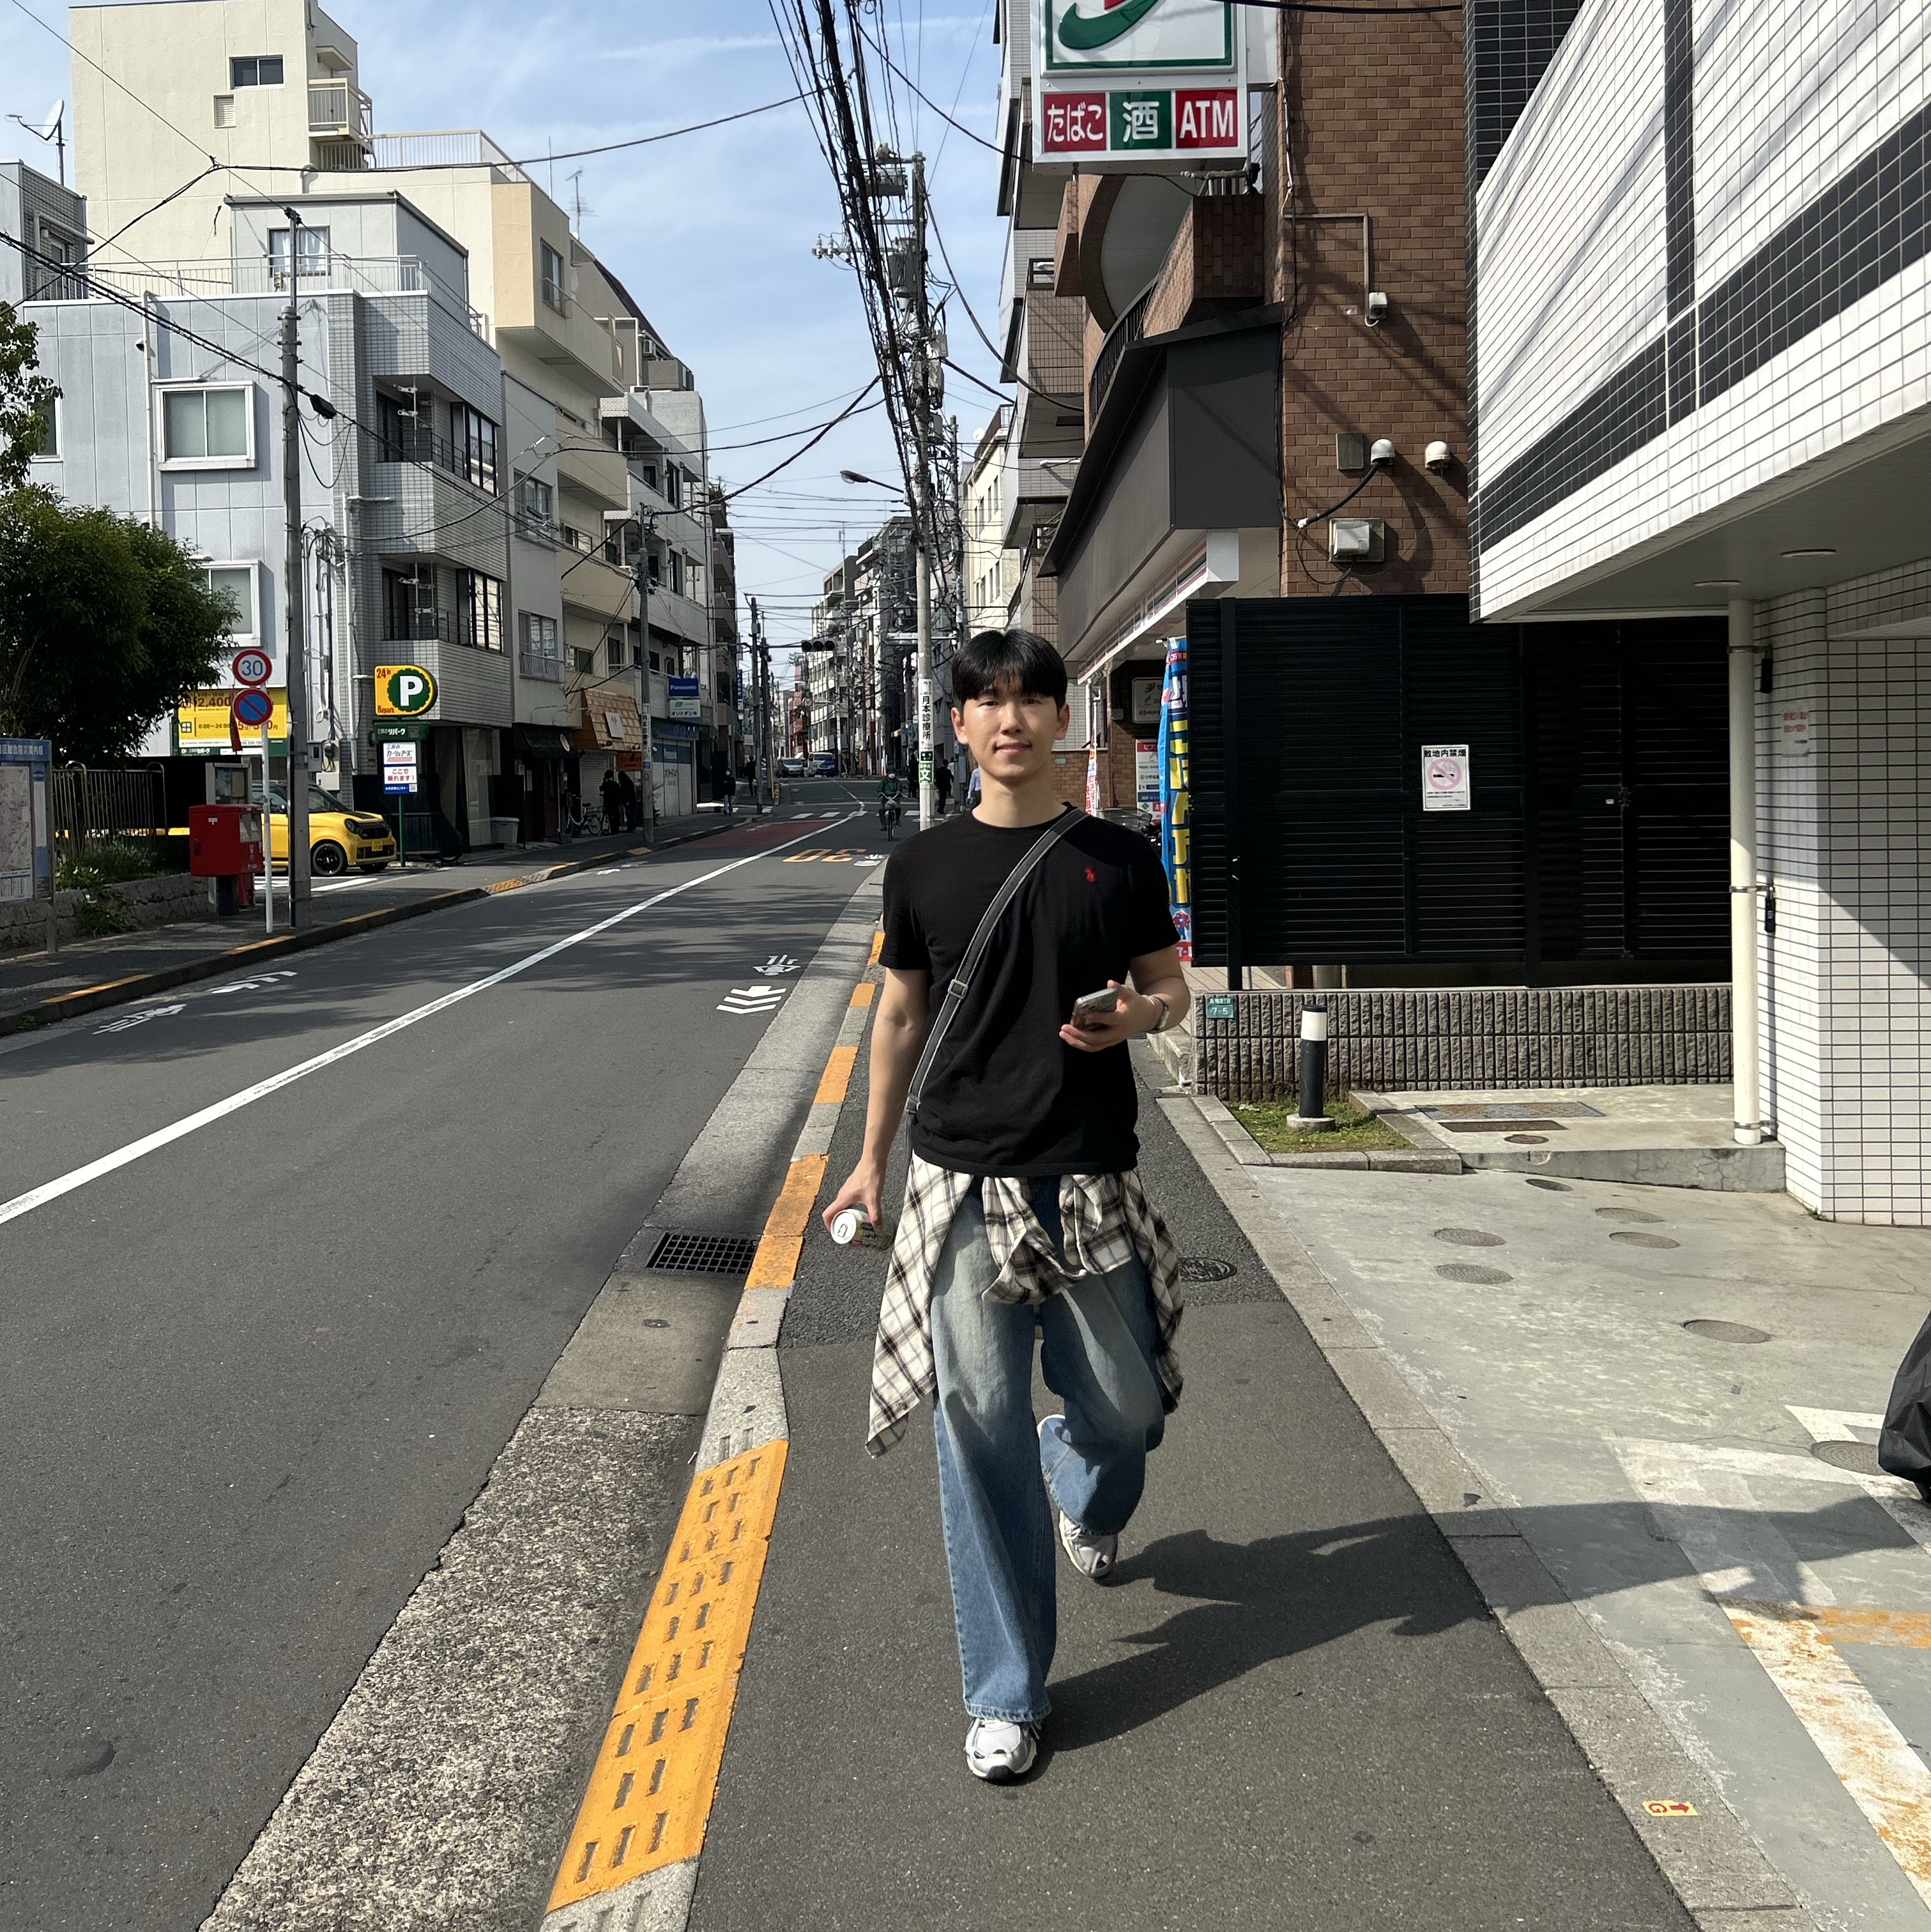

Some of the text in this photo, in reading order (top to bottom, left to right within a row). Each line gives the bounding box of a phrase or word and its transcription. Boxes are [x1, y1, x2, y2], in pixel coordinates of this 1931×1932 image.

[1047, 100, 1104, 143] たばこ
[1122, 100, 1160, 143] 酒
[1179, 100, 1234, 139] ATM
[242, 660, 263, 676] 30
[400, 675, 424, 706] P
[378, 705, 395, 714] Repark
[921, 696, 931, 740] 月本診療所
[919, 768, 931, 781] 文
[1212, 1007, 1228, 1015] 7-5
